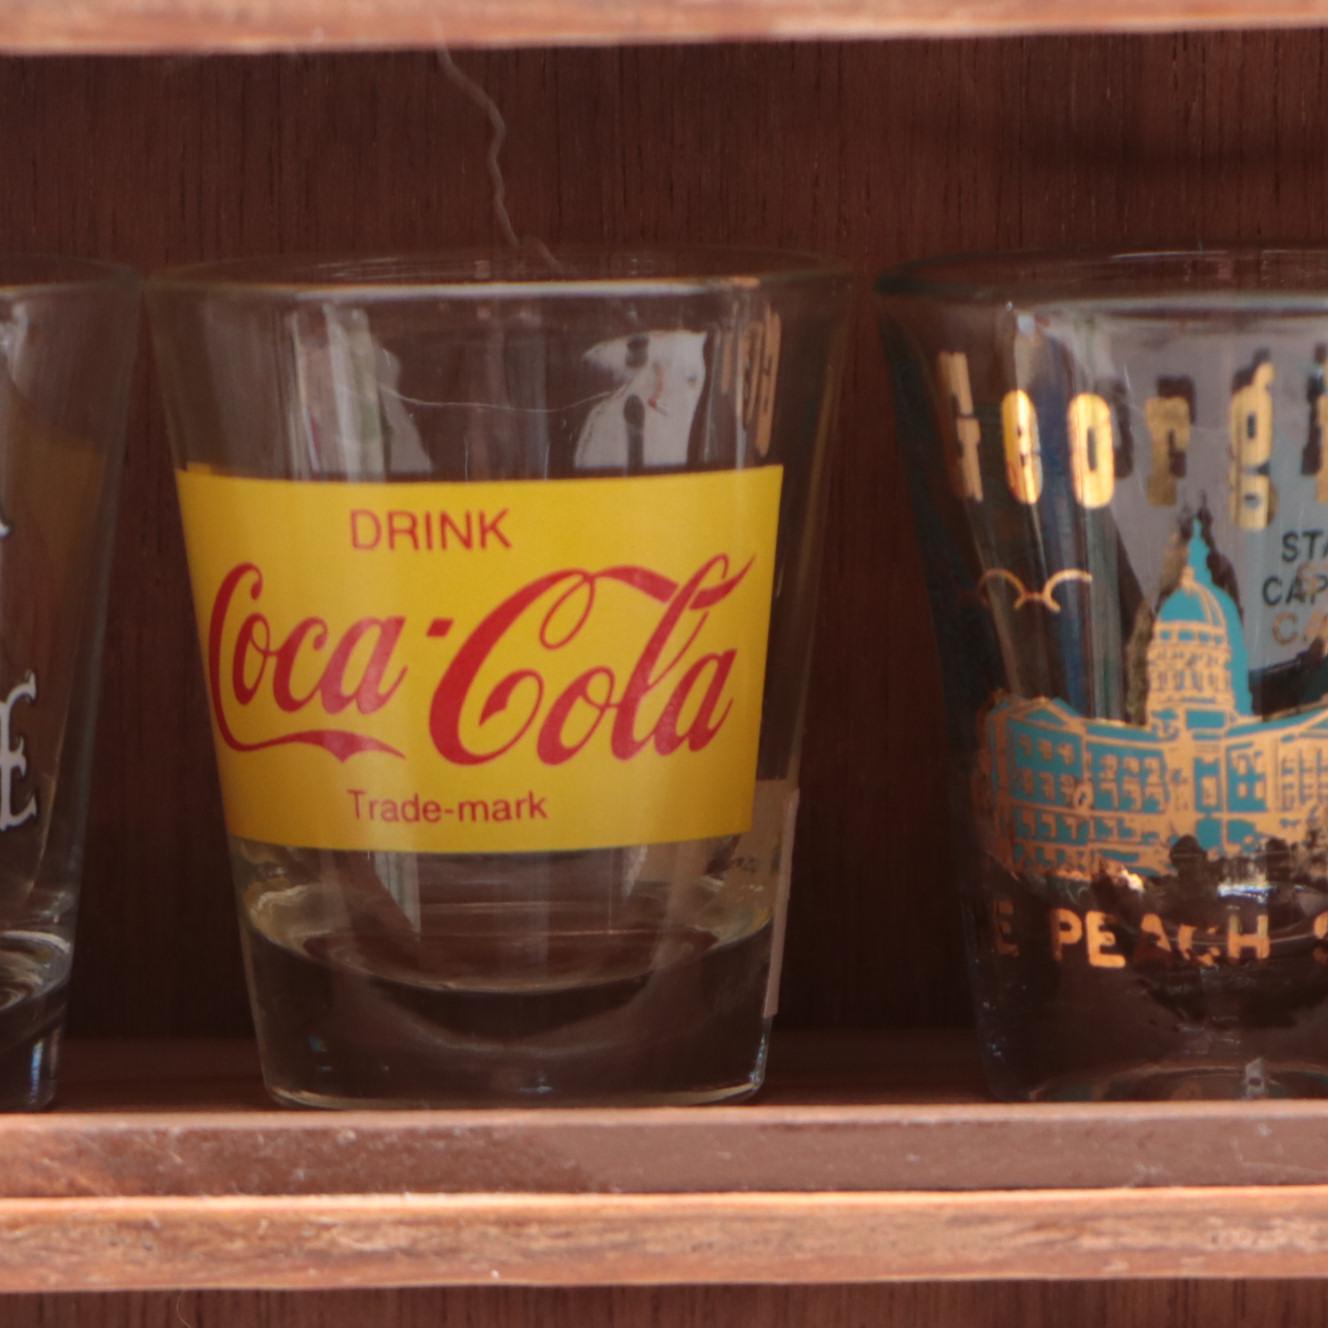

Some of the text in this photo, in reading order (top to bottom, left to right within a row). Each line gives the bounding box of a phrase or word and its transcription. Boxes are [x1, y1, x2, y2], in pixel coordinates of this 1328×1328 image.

[348, 508, 512, 551] DRINK
[208, 553, 756, 766] Coca-Cola
[347, 788, 548, 824] Trade-mark
